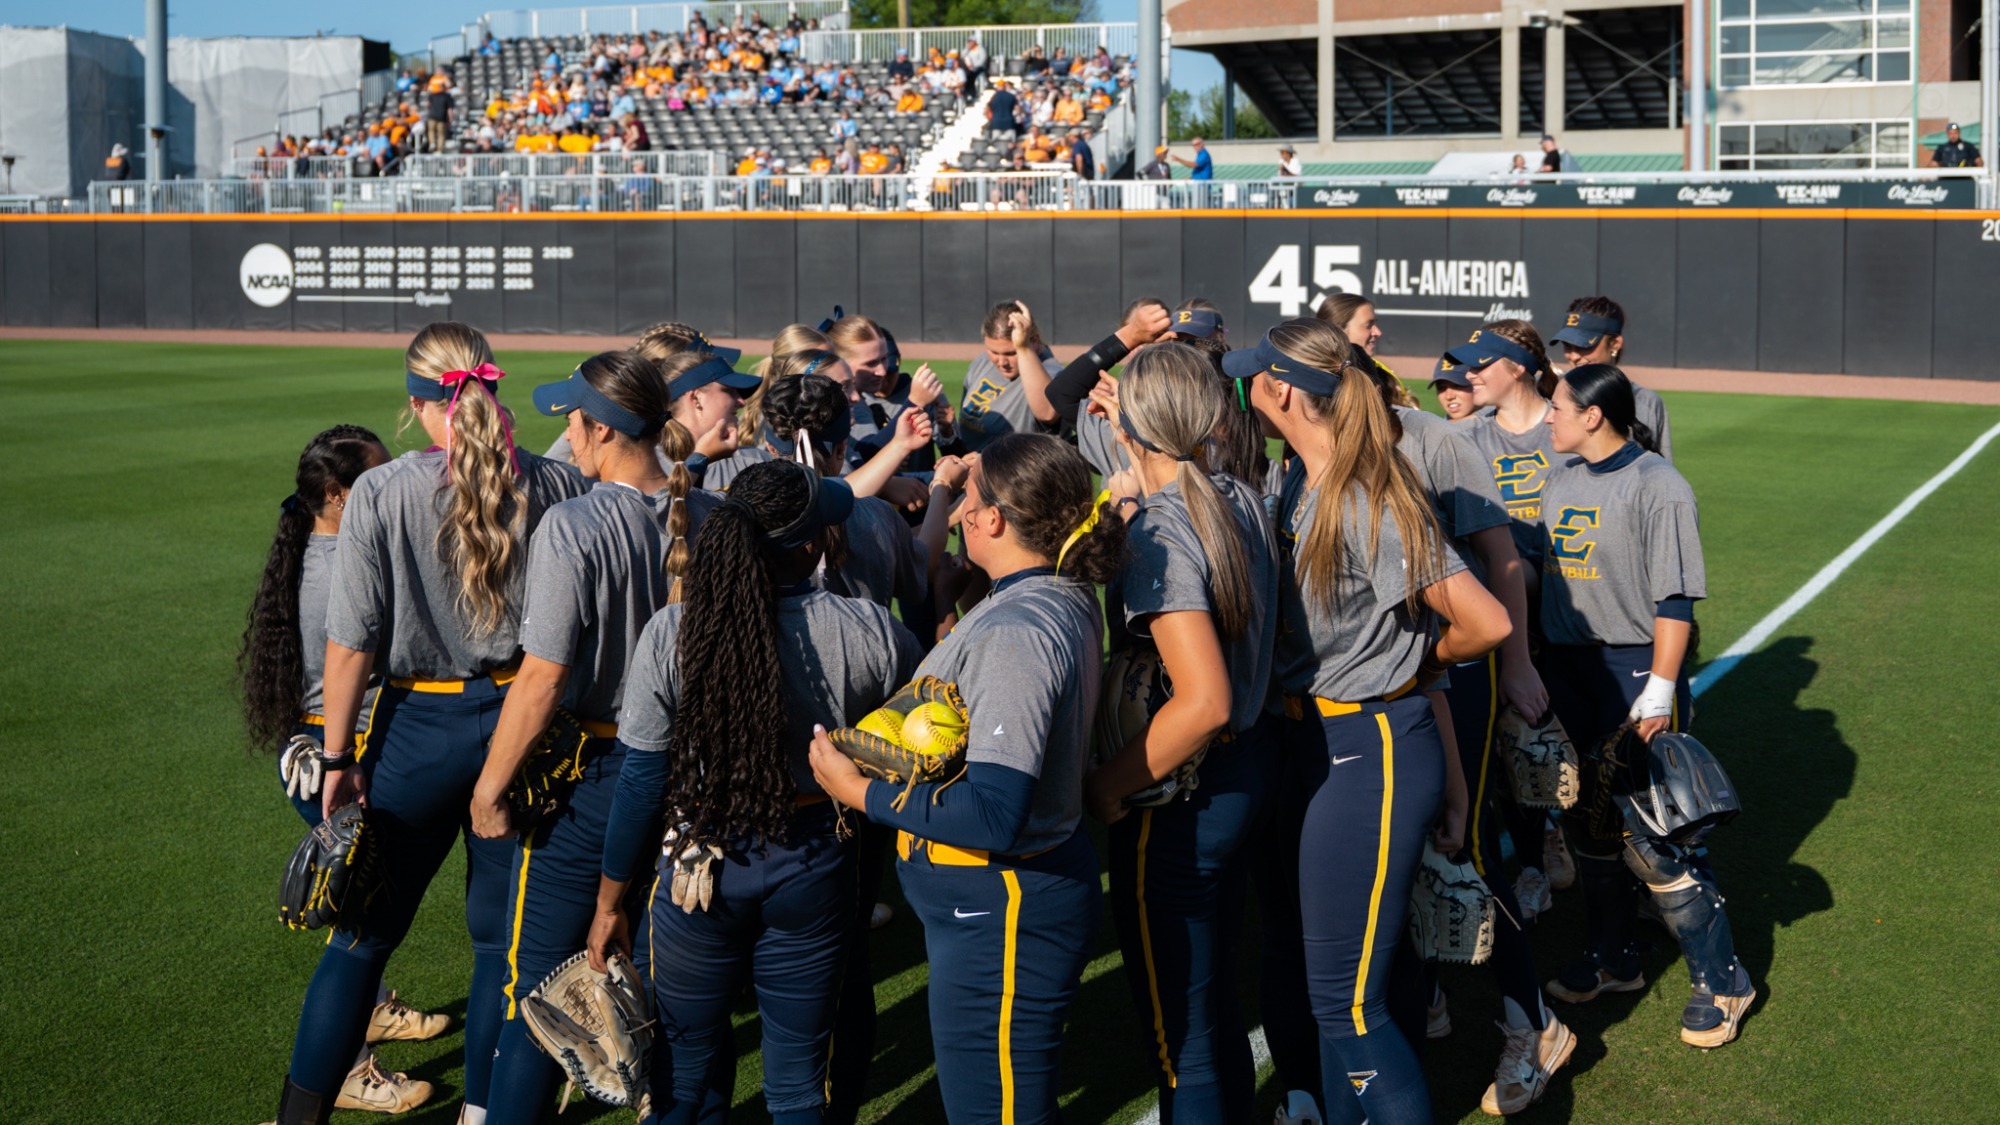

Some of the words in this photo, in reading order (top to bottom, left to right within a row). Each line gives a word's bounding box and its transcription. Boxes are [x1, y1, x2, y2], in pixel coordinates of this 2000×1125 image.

[248, 274, 290, 288] NCAA
[1248, 244, 1363, 317] 45
[1372, 259, 1530, 298] ALL-AMERICA
[1484, 303, 1532, 322] Honors
[1493, 449, 1550, 505] E
[1548, 505, 1600, 564] E
